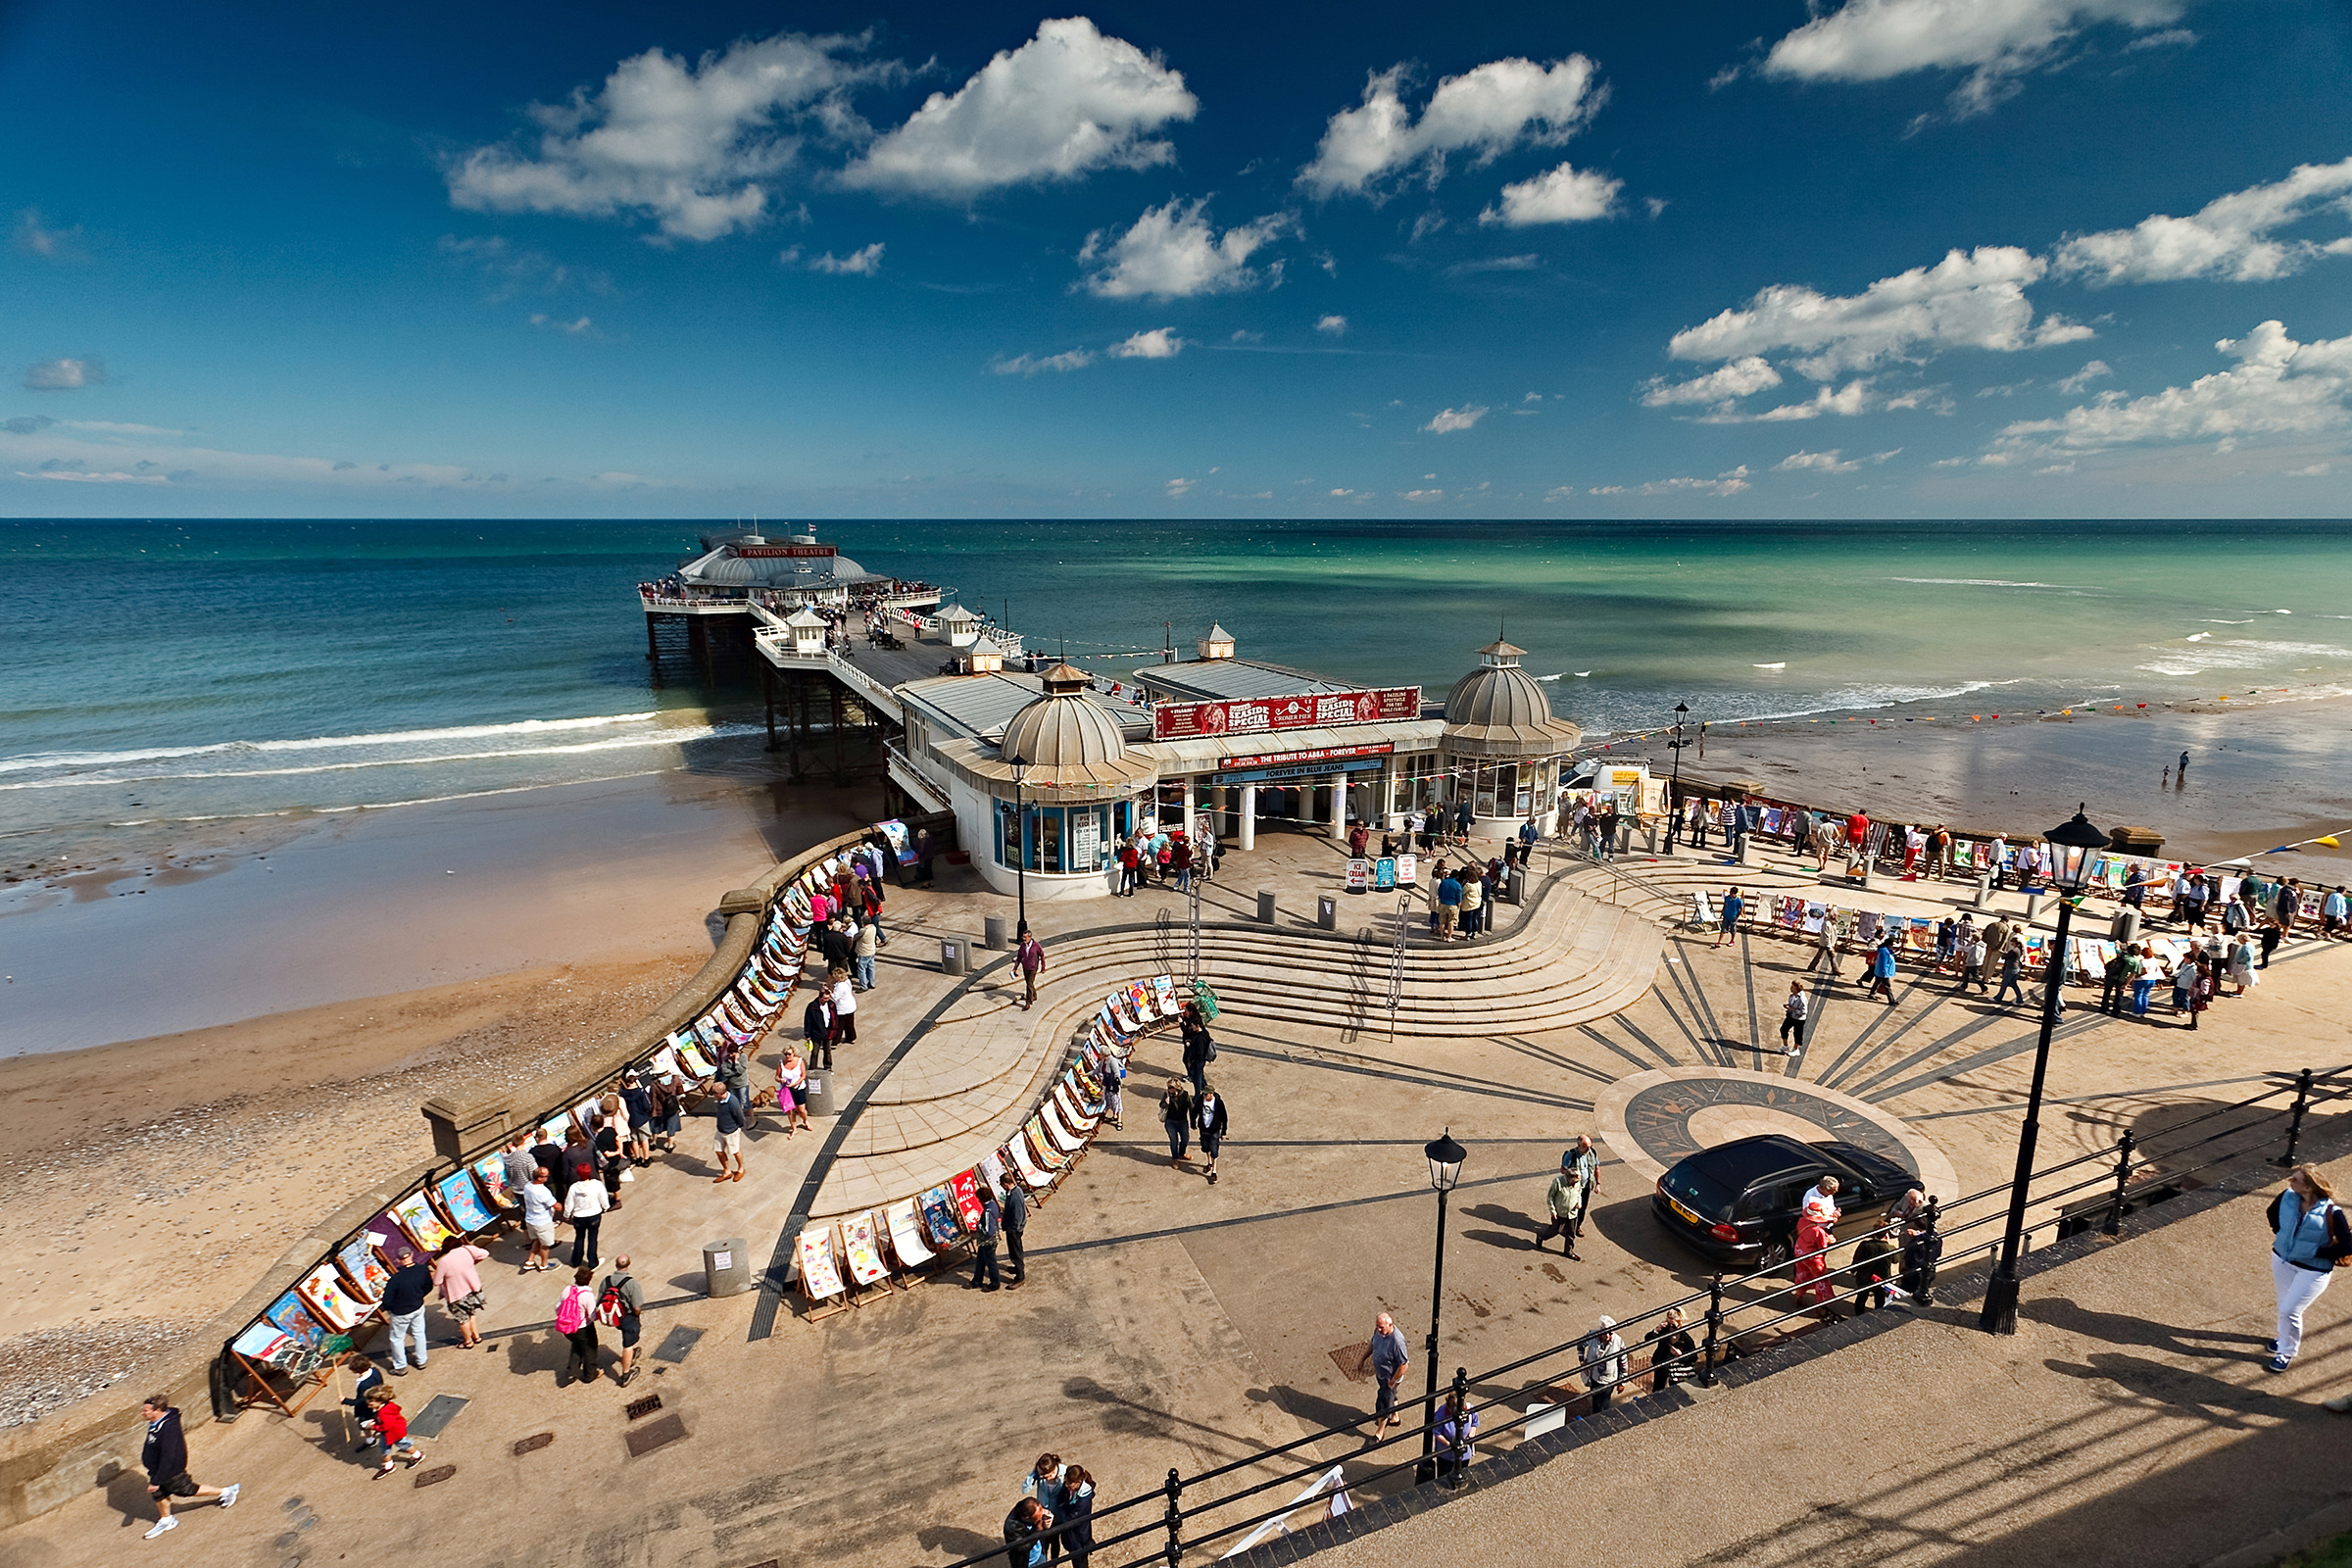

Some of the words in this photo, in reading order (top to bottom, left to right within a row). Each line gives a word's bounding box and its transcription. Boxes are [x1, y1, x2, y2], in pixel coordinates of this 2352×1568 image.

[1317, 700, 1354, 712] SEASIDE
[1229, 706, 1269, 719] SEASIDE
[1316, 708, 1354, 719] SPECIAL
[1229, 715, 1270, 727] SPECIAL
[1260, 755, 1272, 763] THE
[1273, 753, 1298, 761] TRIBUTE
[1307, 750, 1325, 759] ABBA
[1330, 747, 1356, 757] FOREVER
[1265, 768, 1296, 778] FOREVER
